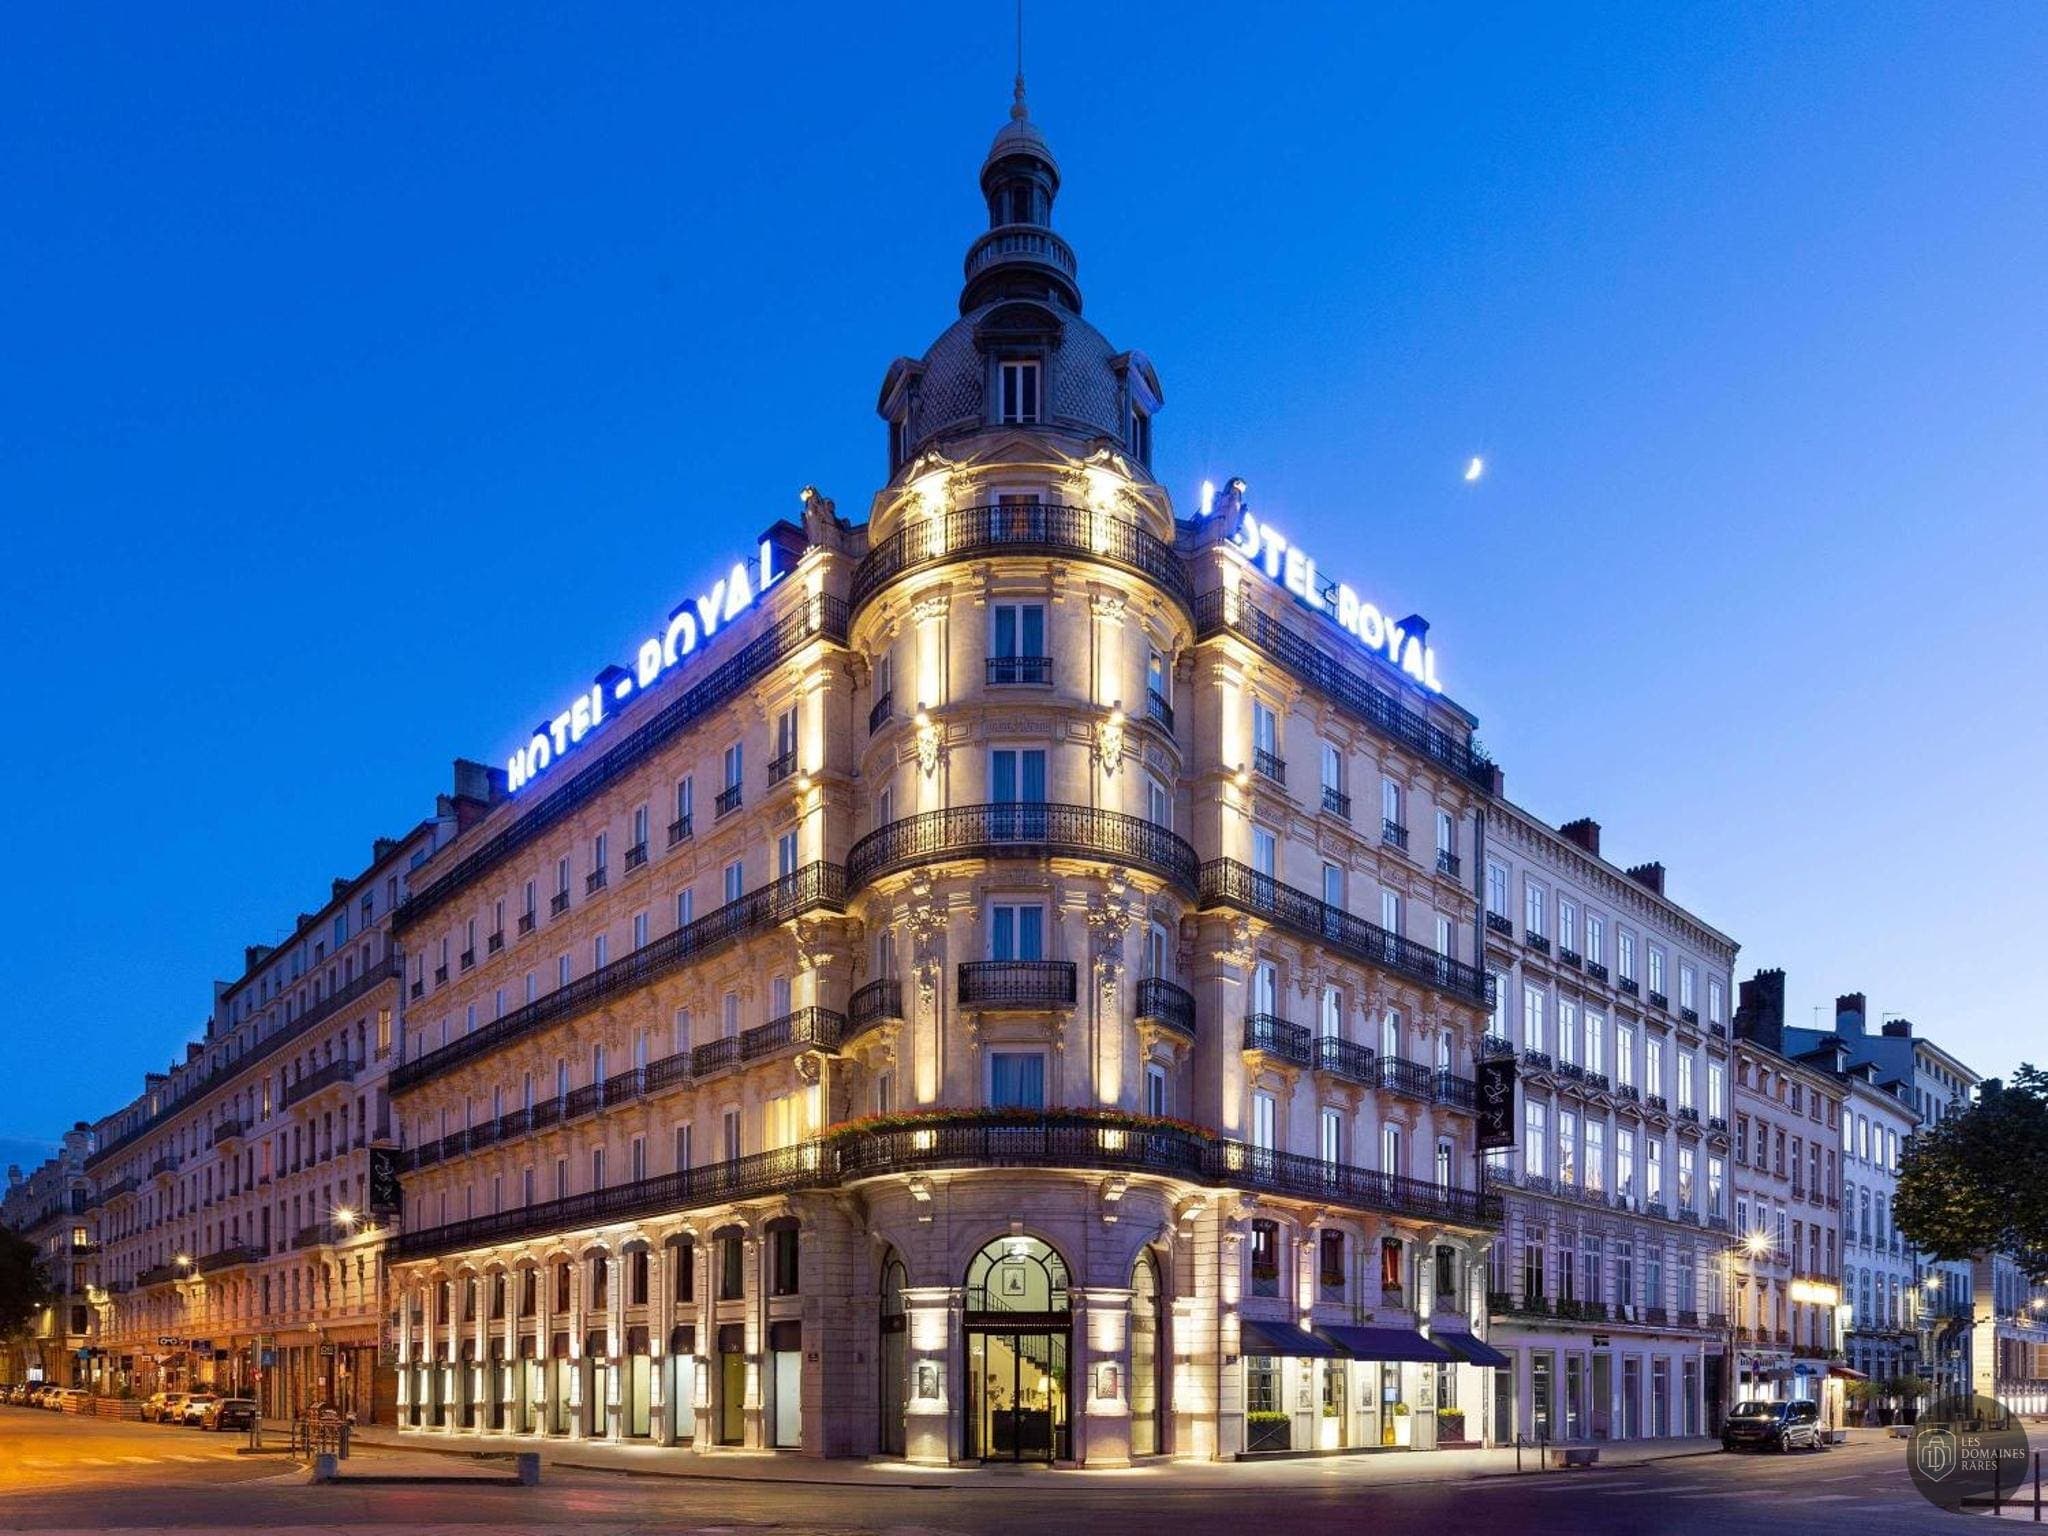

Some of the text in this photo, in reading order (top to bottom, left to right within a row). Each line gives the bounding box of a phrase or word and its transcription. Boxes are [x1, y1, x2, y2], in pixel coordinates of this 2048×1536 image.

[1200, 480, 1324, 608] OTEL
[1338, 583, 1442, 693] ROYAL
[508, 683, 610, 793] HOTEL
